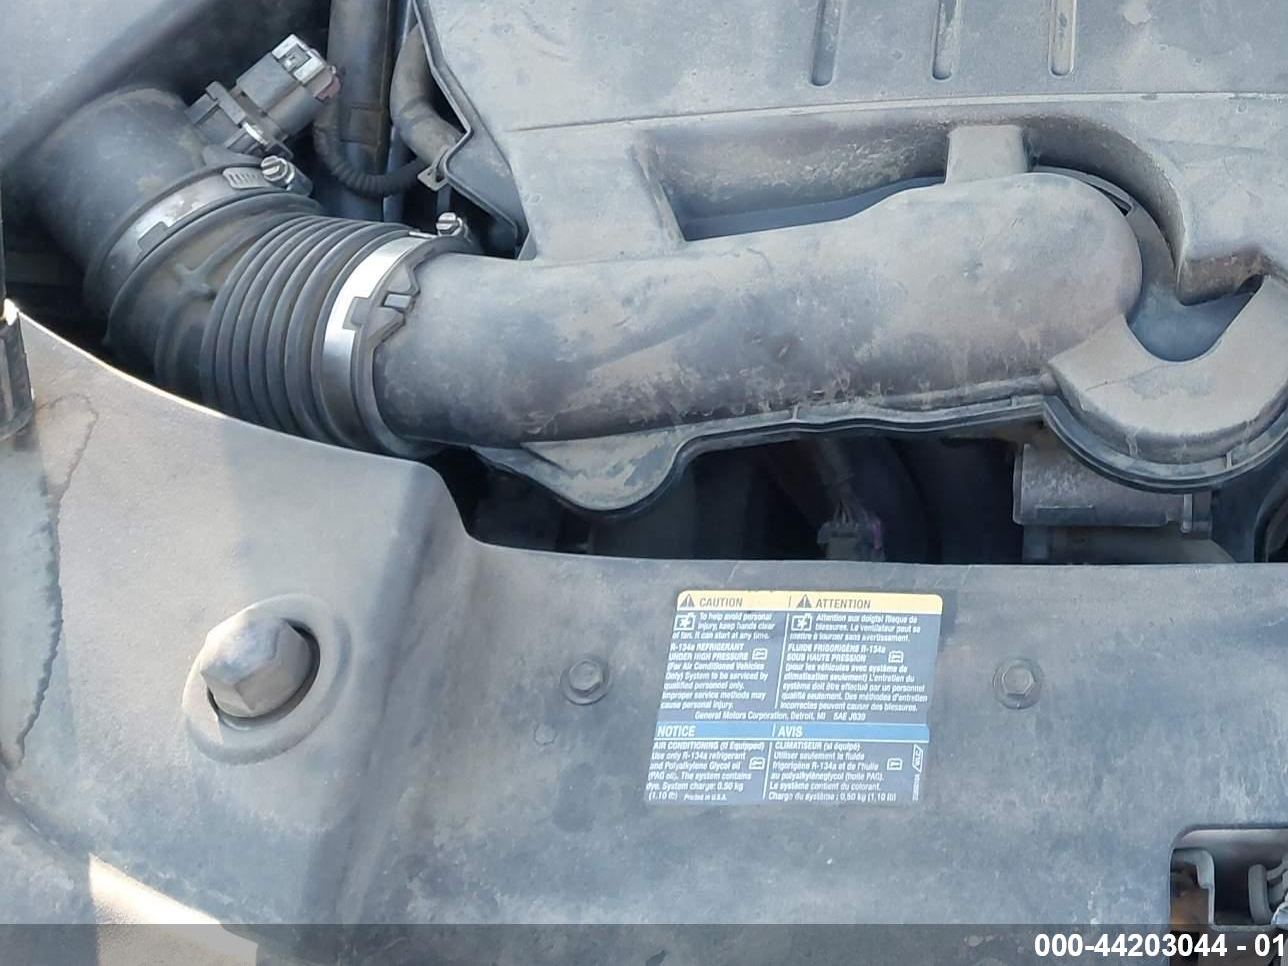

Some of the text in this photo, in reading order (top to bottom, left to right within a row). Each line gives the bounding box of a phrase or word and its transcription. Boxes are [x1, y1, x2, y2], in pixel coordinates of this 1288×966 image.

[700, 598, 743, 608] CAUTION
[816, 599, 871, 609] ATTENTION
[709, 613, 722, 621] help
[743, 614, 772, 622] personal
[698, 622, 717, 631] injury,
[719, 622, 734, 630] keep
[850, 624, 858, 632] Le
[670, 643, 744, 651] R-134a REFRIGERANT
[788, 644, 811, 652] FLUIDE
[832, 654, 866, 662] PRESSION
[667, 662, 681, 670] (For
[683, 662, 692, 670] Air
[685, 672, 709, 680] System
[711, 672, 718, 680] to
[720, 672, 728, 680] be
[730, 672, 758, 680] serviced
[760, 672, 768, 681] by
[662, 691, 692, 700] Improper
[751, 692, 766, 700] may
[682, 701, 712, 710] personal
[695, 712, 722, 720] General
[723, 712, 746, 720] Motors
[833, 712, 847, 720] SAE
[657, 726, 696, 737] NOTICE
[778, 726, 803, 737] AVIS
[653, 742, 666, 750] AIR
[667, 742, 718, 750] CONDITIONING
[775, 742, 822, 750] CLIMATISEUR
[652, 752, 746, 761] Use only R-134a refrigerant
[650, 762, 663, 770] and
[709, 762, 730, 771] Glycol
[732, 762, 740, 770] oil
[695, 773, 720, 781] system
[662, 782, 688, 790] System
[734, 782, 744, 792] kg
